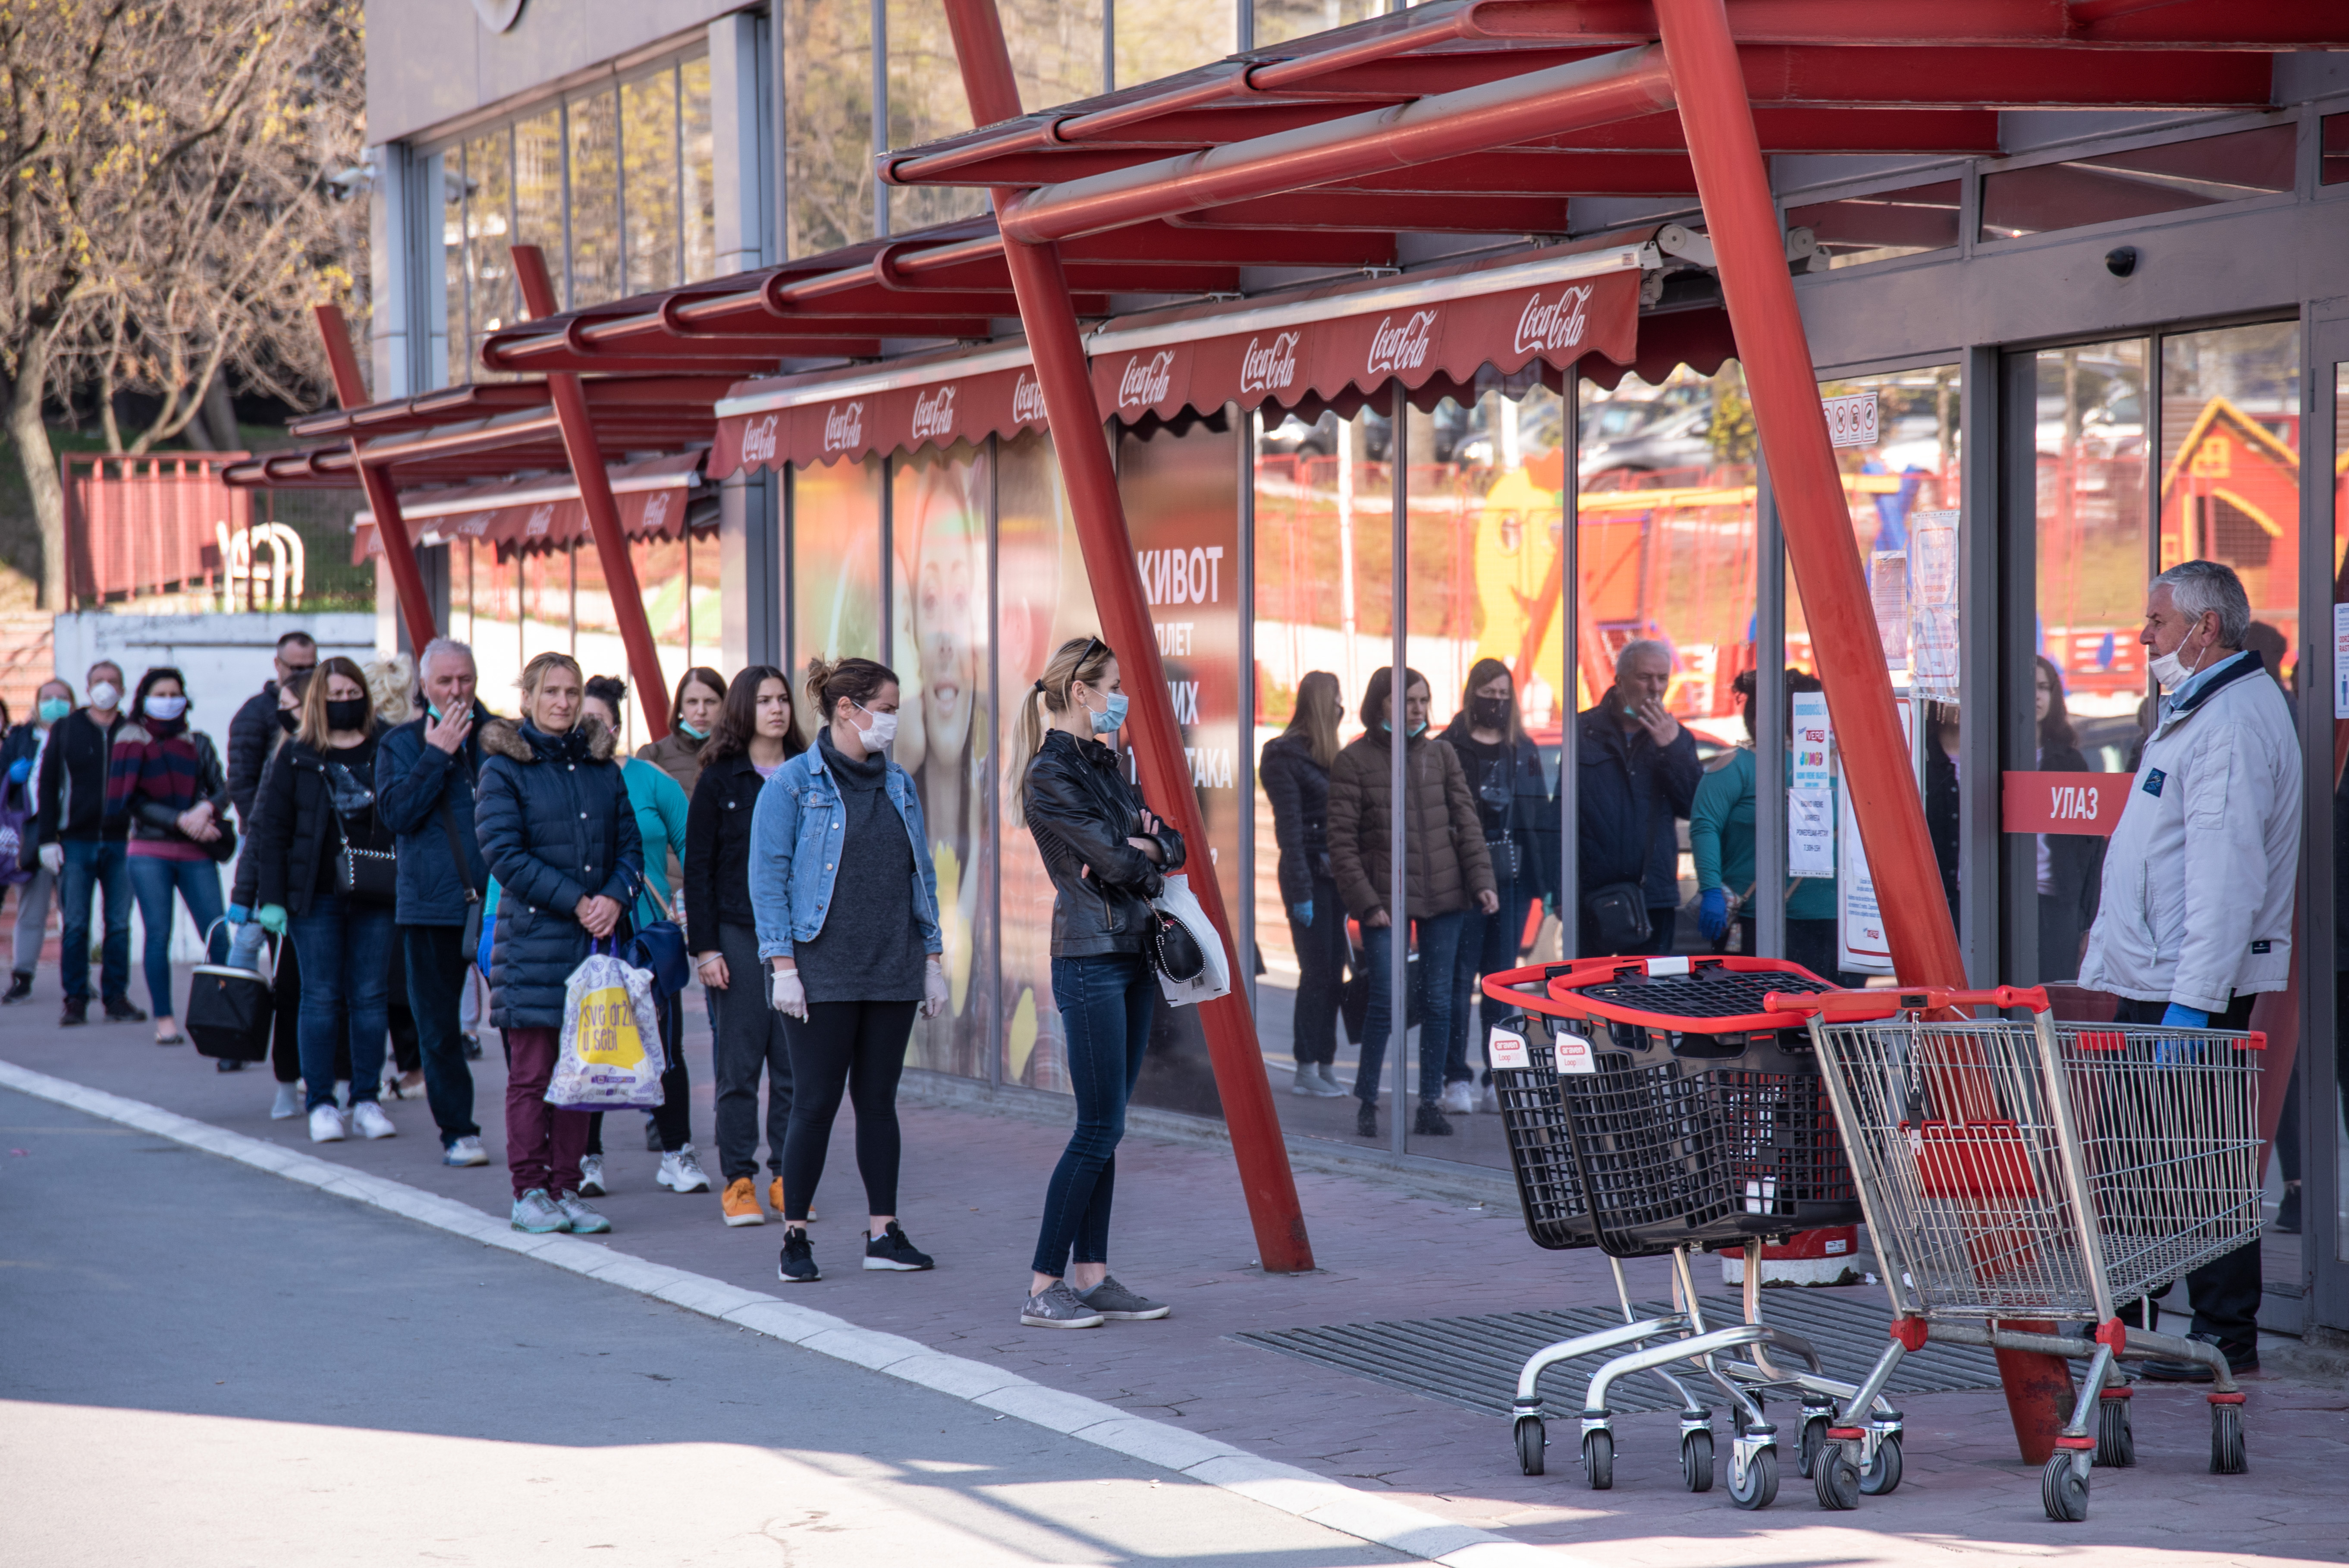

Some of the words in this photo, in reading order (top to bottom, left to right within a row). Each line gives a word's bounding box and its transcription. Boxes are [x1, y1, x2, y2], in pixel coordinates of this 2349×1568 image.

[1367, 309, 1438, 374] Coca-Cola
[1514, 284, 1593, 354] Coca-Cola
[1119, 350, 1175, 408] Coca-Cola
[1241, 332, 1301, 393] Coca-Cola
[825, 402, 864, 452] Coca-Cola
[912, 385, 955, 439] Coca-Cola
[742, 415, 778, 463] Coca-Cola
[1807, 731, 1824, 740] VERO
[2050, 787, 2098, 820] УЛАЗ
[583, 1030, 589, 1051] u
[594, 1026, 618, 1051] sebi
[584, 1004, 606, 1028] sve
